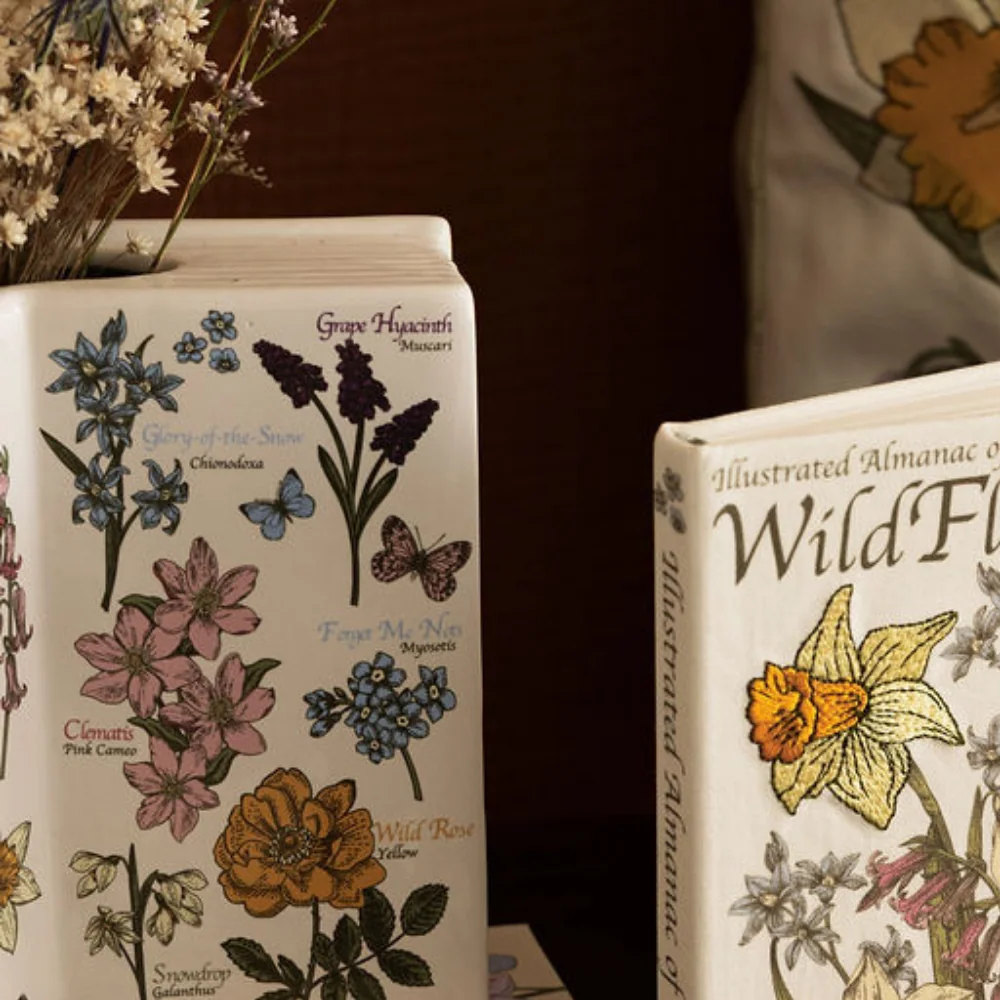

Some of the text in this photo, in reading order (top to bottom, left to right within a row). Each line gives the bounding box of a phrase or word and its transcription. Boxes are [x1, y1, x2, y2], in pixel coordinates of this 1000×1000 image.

[315, 304, 453, 343] Grape Hyacinth
[399, 338, 453, 352] Muscari
[189, 453, 265, 470] Chionodoxa
[711, 445, 857, 492] Illustrated
[860, 440, 979, 476] Almanac
[378, 617, 414, 641] Me
[399, 641, 457, 659] Myosotis
[661, 550, 686, 777] Illustrated
[64, 718, 134, 741] Clematis
[62, 741, 138, 757] Pink Cameo
[374, 817, 476, 842] Wild Rose
[377, 844, 419, 860] Yellow
[662, 771, 687, 952] Almanac
[152, 960, 232, 990] Snowdrop
